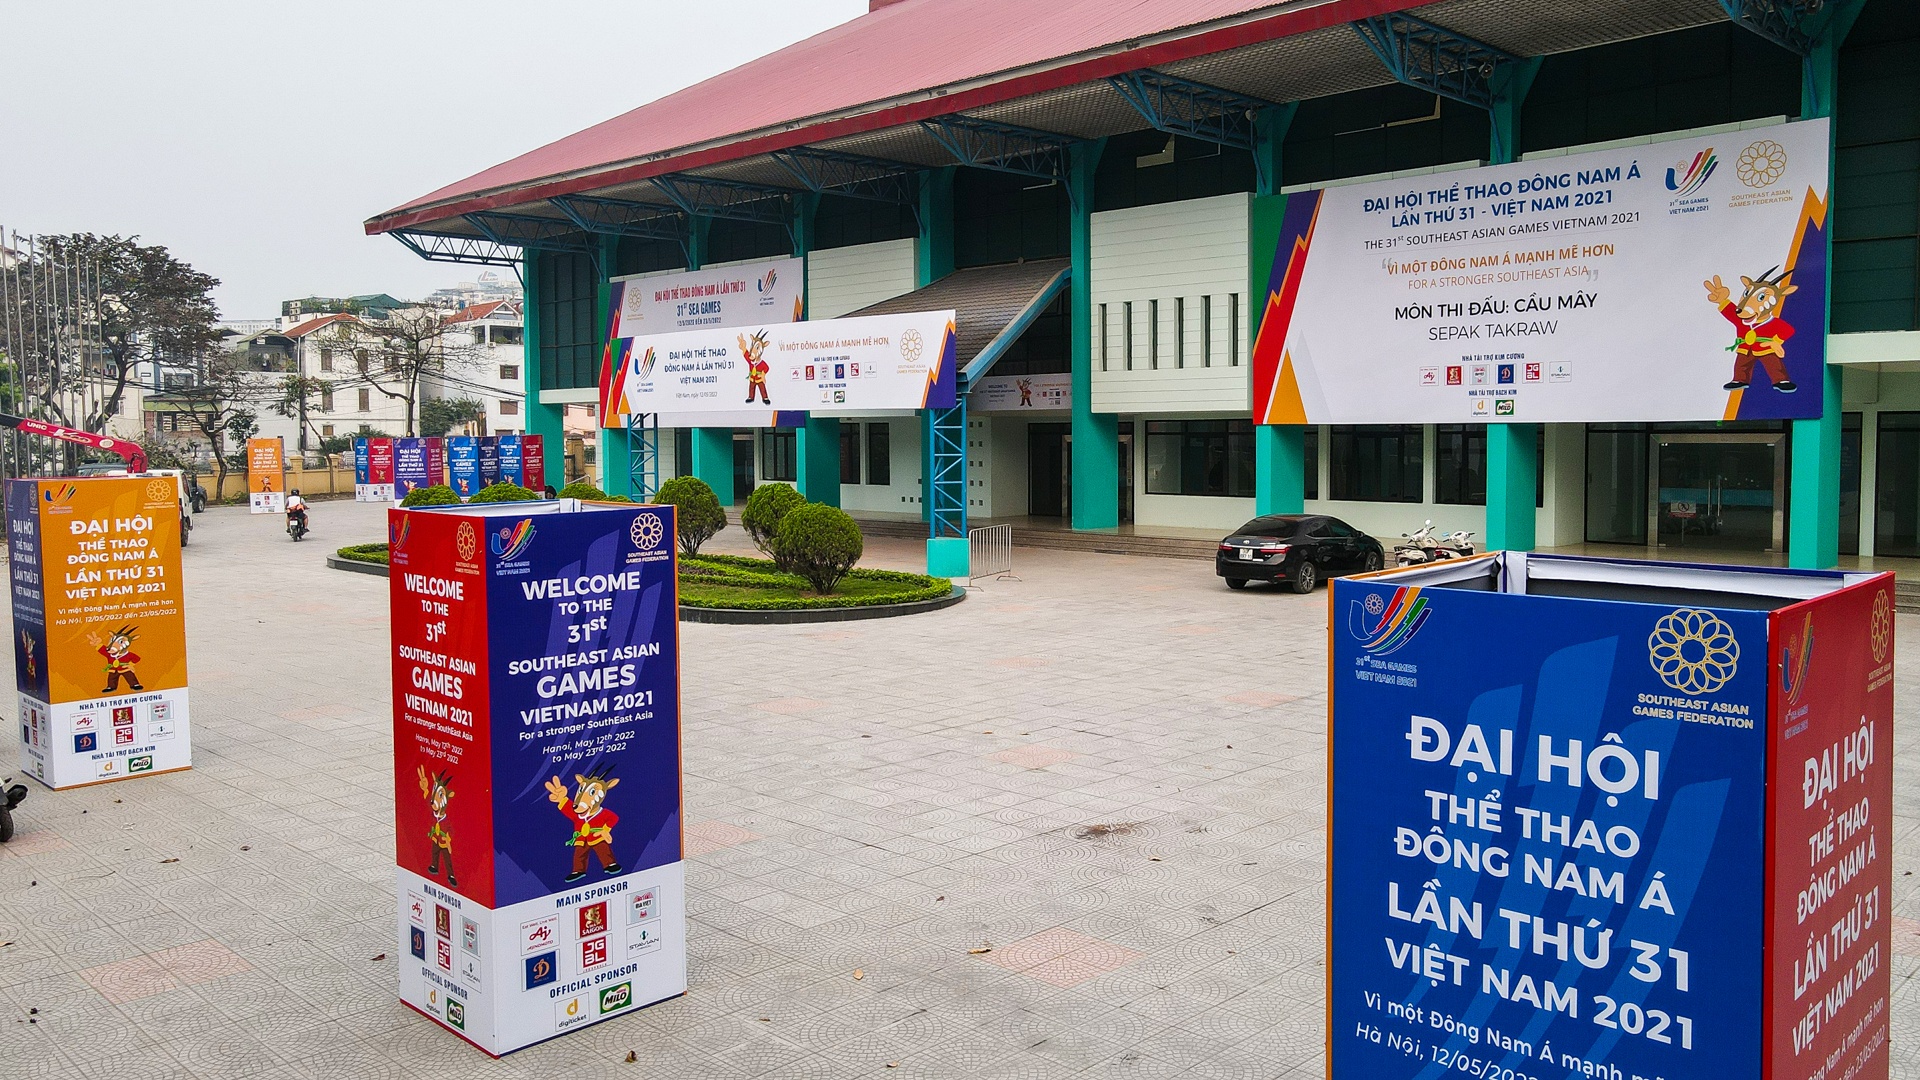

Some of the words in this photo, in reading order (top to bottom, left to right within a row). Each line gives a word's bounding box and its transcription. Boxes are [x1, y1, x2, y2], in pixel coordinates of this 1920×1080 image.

[1363, 197, 1389, 214] ĐẠI
[1395, 190, 1422, 210] HỘI
[1427, 182, 1459, 204] THỂ
[1464, 181, 1512, 200] THAO
[1517, 173, 1571, 194] ĐÔNG
[1577, 167, 1621, 186] NAM
[1627, 160, 1641, 180] Á
[1731, 191, 1770, 201] SOUTHEAST
[1770, 189, 1791, 197] ASIAN
[1752, 196, 1793, 206] FEDERATION
[1392, 210, 1420, 227] LẦN
[1424, 206, 1455, 224] THỨ
[1459, 207, 1474, 220] 31
[1491, 199, 1526, 218] VIỆT
[1531, 195, 1569, 212] NAM
[1574, 190, 1612, 207] 2021
[1364, 240, 1383, 250] THE
[1386, 235, 1404, 248] 31st
[1406, 230, 1469, 246] SOUTHEAST
[1471, 226, 1505, 239] ASIAN
[1508, 221, 1549, 235] GAMES
[1552, 215, 1607, 231] VIETNAM
[1611, 211, 1640, 225] 2021
[1401, 259, 1427, 274] MỘT
[1430, 258, 1466, 272] ĐÔNG
[1470, 255, 1499, 268] NAM
[1502, 251, 1511, 265] Á
[1514, 250, 1555, 267] MẠNH
[1559, 244, 1578, 259] MẼ
[1582, 243, 1614, 257] HƠN
[1408, 279, 1428, 290] FOR
[1429, 279, 1437, 288] A
[1439, 271, 1494, 287] STRONGER
[1497, 267, 1561, 283] SOUTHEAST
[688, 303, 699, 316] SEA
[701, 300, 721, 313] GAMES
[1395, 302, 1433, 320] MÔN
[1437, 303, 1463, 318] THI
[1468, 295, 1509, 316] ĐẤU:
[1514, 292, 1551, 312] CẦU
[1557, 290, 1598, 309] MÂY
[1428, 324, 1480, 341] SEPAK
[1485, 319, 1559, 338] TAKRAW
[664, 362, 680, 373] ĐÔNG
[681, 363, 695, 372] NAM
[696, 360, 701, 371] Á
[728, 361, 735, 369] 31
[669, 351, 680, 361] ĐẠI
[681, 348, 693, 362] HỘI
[708, 347, 727, 357] THAO
[680, 375, 691, 385] VIỆT
[692, 375, 705, 384] NAM
[705, 375, 718, 383] 2021
[27, 421, 47, 431] UNIC
[69, 519, 108, 537] ĐẠI
[115, 513, 153, 534] HỘI
[67, 551, 109, 565] ĐÔNG
[113, 550, 145, 561] NAM
[148, 547, 159, 560] Á
[78, 536, 106, 552] THỂ
[109, 537, 149, 549] THAO
[65, 567, 101, 584] LẦN
[107, 564, 144, 582] THỨ
[146, 565, 164, 578] 31
[404, 573, 464, 601] WELCOME
[521, 571, 641, 600] WELCOME
[65, 584, 99, 601] VIỆT
[101, 583, 134, 596] NAM
[136, 582, 166, 593] 2021
[421, 599, 433, 613] TO
[433, 602, 449, 617] THE
[558, 601, 579, 616] TO
[583, 598, 613, 614] THE
[426, 620, 447, 643] 31st
[567, 615, 607, 644] 31st
[399, 644, 448, 669] SOUTHEAST
[449, 656, 476, 676] ASIAN
[508, 649, 607, 676] SOUTHEAST
[612, 642, 660, 662] ASIAN
[412, 666, 463, 700] GAMES
[536, 664, 637, 699] GAMES
[405, 693, 448, 721] VIETNAM
[450, 706, 473, 728] 2021
[520, 696, 609, 727] VIETNAM
[613, 690, 653, 711] 2021
[1632, 705, 1674, 720] GAMES
[1676, 710, 1754, 730] FEDERATION
[1637, 693, 1709, 711] SOUTHEAST
[1711, 702, 1749, 716] ASIAN
[519, 730, 533, 742] For
[545, 721, 585, 739] stronger
[587, 713, 632, 731] SouthEast
[634, 709, 653, 722] Asia
[542, 741, 573, 756] Hanoi,
[575, 737, 594, 752] May
[596, 732, 613, 747] 12th
[615, 730, 635, 743] 2022
[552, 755, 562, 763] to
[564, 751, 584, 763] May
[585, 745, 604, 759] 23rd
[606, 742, 627, 753] 2022
[1405, 714, 1513, 783] ĐẠI
[1537, 732, 1660, 808] HỘI
[1802, 742, 1839, 811] ĐẠI
[1844, 714, 1874, 784] HỘI
[1424, 788, 1502, 833] THỂ
[1515, 806, 1640, 858] THAO
[1808, 808, 1835, 868] THỂ
[1837, 796, 1869, 847] THAO
[1394, 826, 1510, 878] ĐÔNG
[1524, 857, 1624, 904] NAM
[1639, 871, 1675, 916] Á
[1797, 873, 1836, 926] ĐÔNG
[1838, 841, 1865, 890] NAM
[1867, 825, 1876, 865] Á
[556, 892, 582, 908] MAIN
[584, 880, 628, 901] SPONSOR
[582, 925, 604, 935] SAIGON
[1387, 877, 1483, 941] LẦN
[1499, 908, 1613, 971] THỨ
[1628, 940, 1690, 993] 31
[1794, 930, 1827, 1001] LẦN
[1831, 893, 1863, 962] THỨ
[1864, 885, 1879, 930] 31
[549, 978, 592, 999] OFFICIAL
[594, 963, 638, 984] SPONSOR
[1385, 937, 1470, 988] VIỆT
[1482, 964, 1578, 1020] NAM
[1593, 994, 1693, 1051] 2021
[604, 991, 627, 1006] MILO
[1792, 1000, 1823, 1057] VIỆT
[1825, 968, 1853, 1024] NAM
[1855, 941, 1879, 991] 2021
[559, 1014, 587, 1028] digiticket
[1363, 990, 1381, 1011] Vì
[1387, 1000, 1424, 1025] một
[1429, 1010, 1480, 1044] Đông
[1486, 1027, 1533, 1057] Nam
[1539, 1041, 1555, 1064] Á
[1561, 1052, 1623, 1080] mạnh
[1356, 1022, 1381, 1044] Hà
[1387, 1032, 1424, 1061] Nội,
